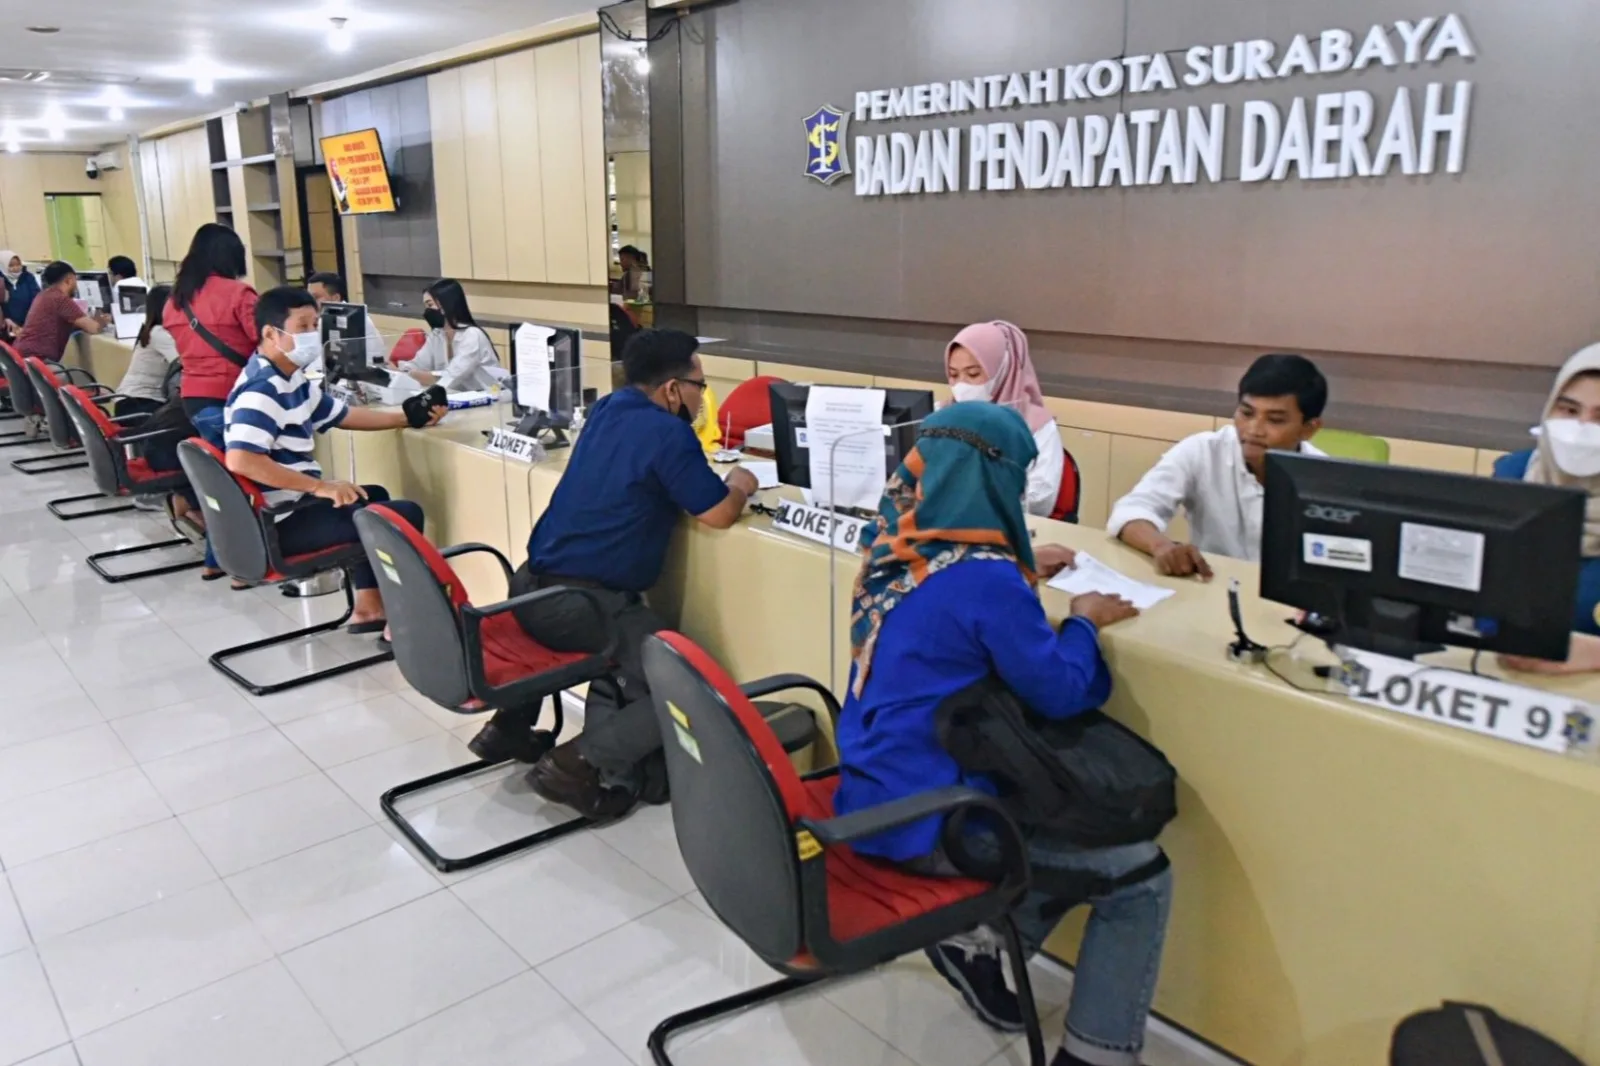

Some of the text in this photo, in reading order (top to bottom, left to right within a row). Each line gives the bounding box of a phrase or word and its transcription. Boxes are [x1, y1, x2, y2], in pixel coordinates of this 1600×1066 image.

[855, 13, 1476, 122] PEMERINTAH KOTA SURABAYA
[855, 80, 1472, 197] BADAN PENDAPATAN DAERAH
[494, 432, 526, 455] LOKET
[780, 504, 857, 545] LOKET 8
[1304, 503, 1363, 523] acer
[1360, 673, 1552, 740] LOKET 9
